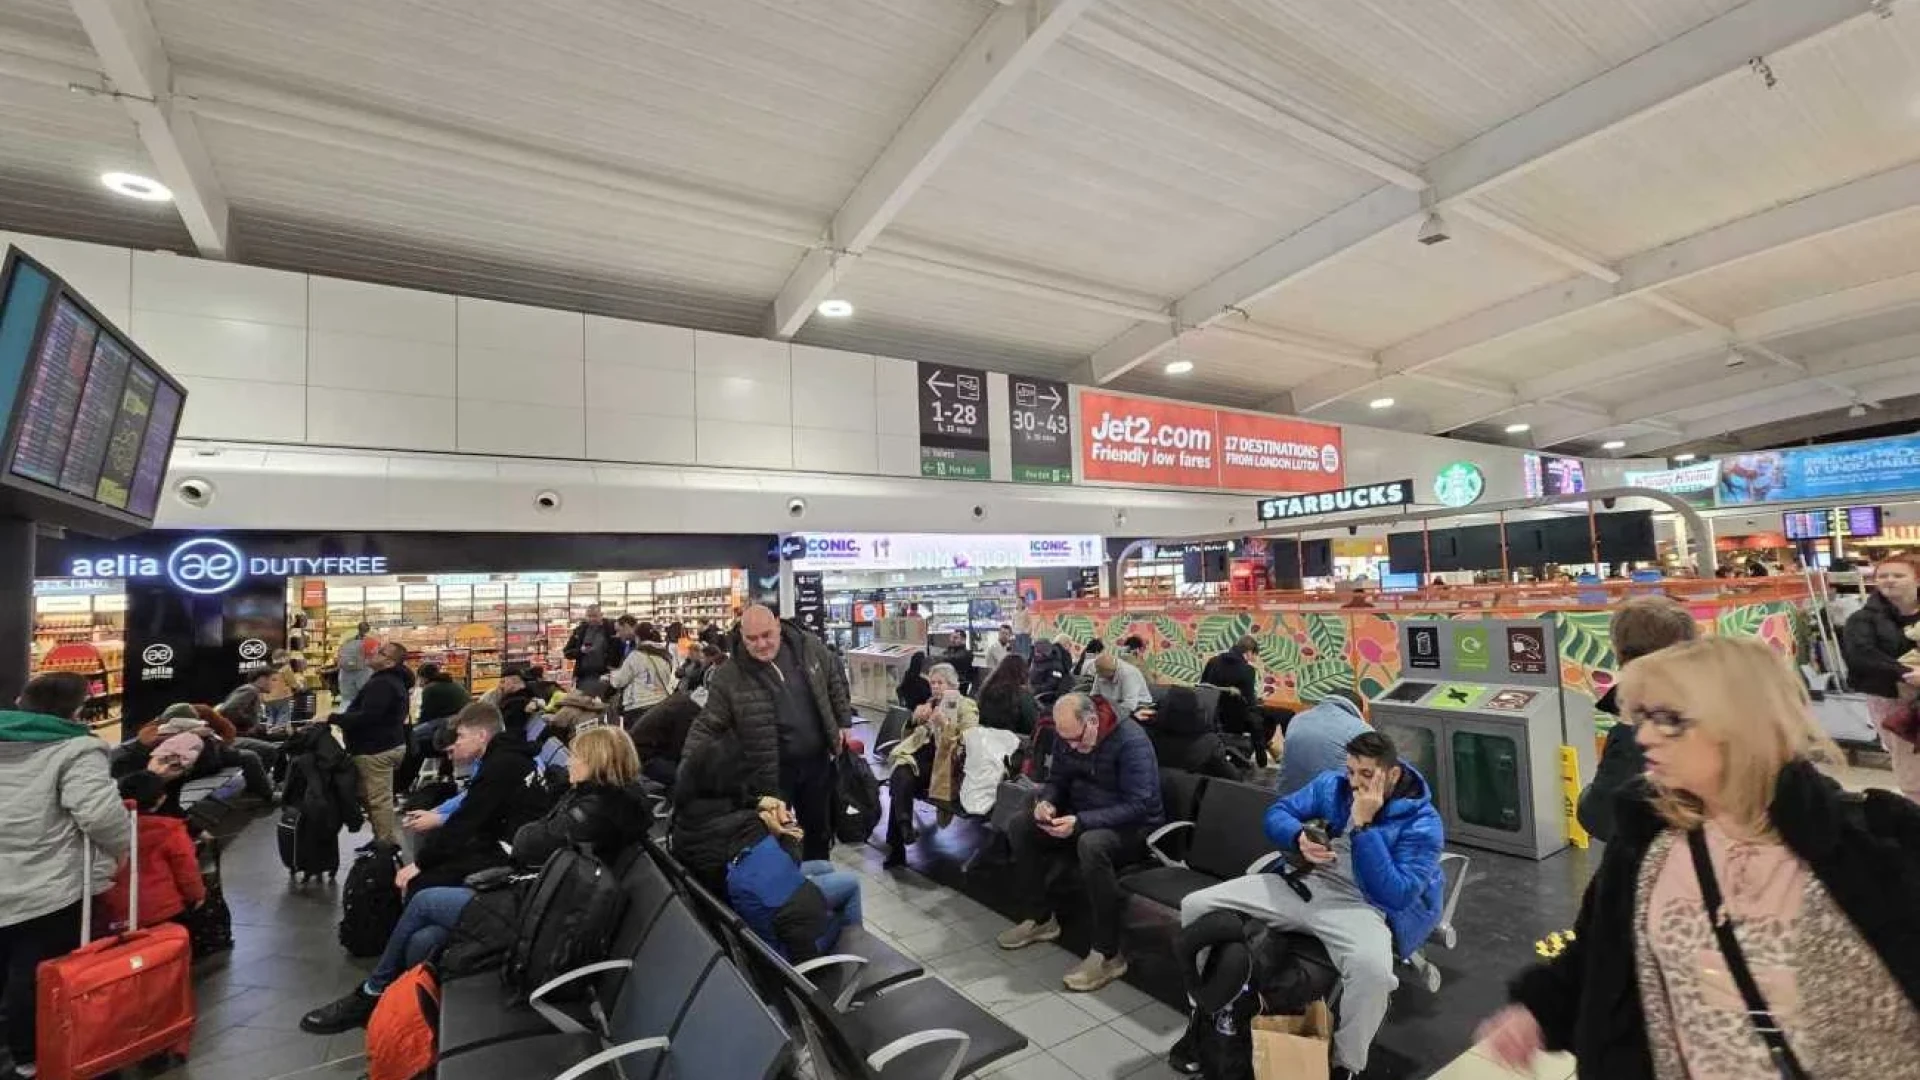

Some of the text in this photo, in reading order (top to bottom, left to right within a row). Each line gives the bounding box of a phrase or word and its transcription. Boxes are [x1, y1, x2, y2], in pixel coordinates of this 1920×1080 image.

[931, 400, 977, 425] 1-28
[1012, 410, 1068, 434] 30-43
[1091, 411, 1211, 450] Jet2.com
[1092, 442, 1211, 468] Friendly low fares
[1225, 435, 1239, 450] 17
[1240, 437, 1319, 459] DESTINATIONS
[1226, 452, 1319, 471] FROM LONDON LUTON
[1263, 484, 1403, 518] STARBUCKS
[806, 539, 861, 552] CONIC.
[72, 554, 158, 577] aelia
[250, 556, 388, 575] DUTYFREE
[141, 666, 174, 676] aelia
